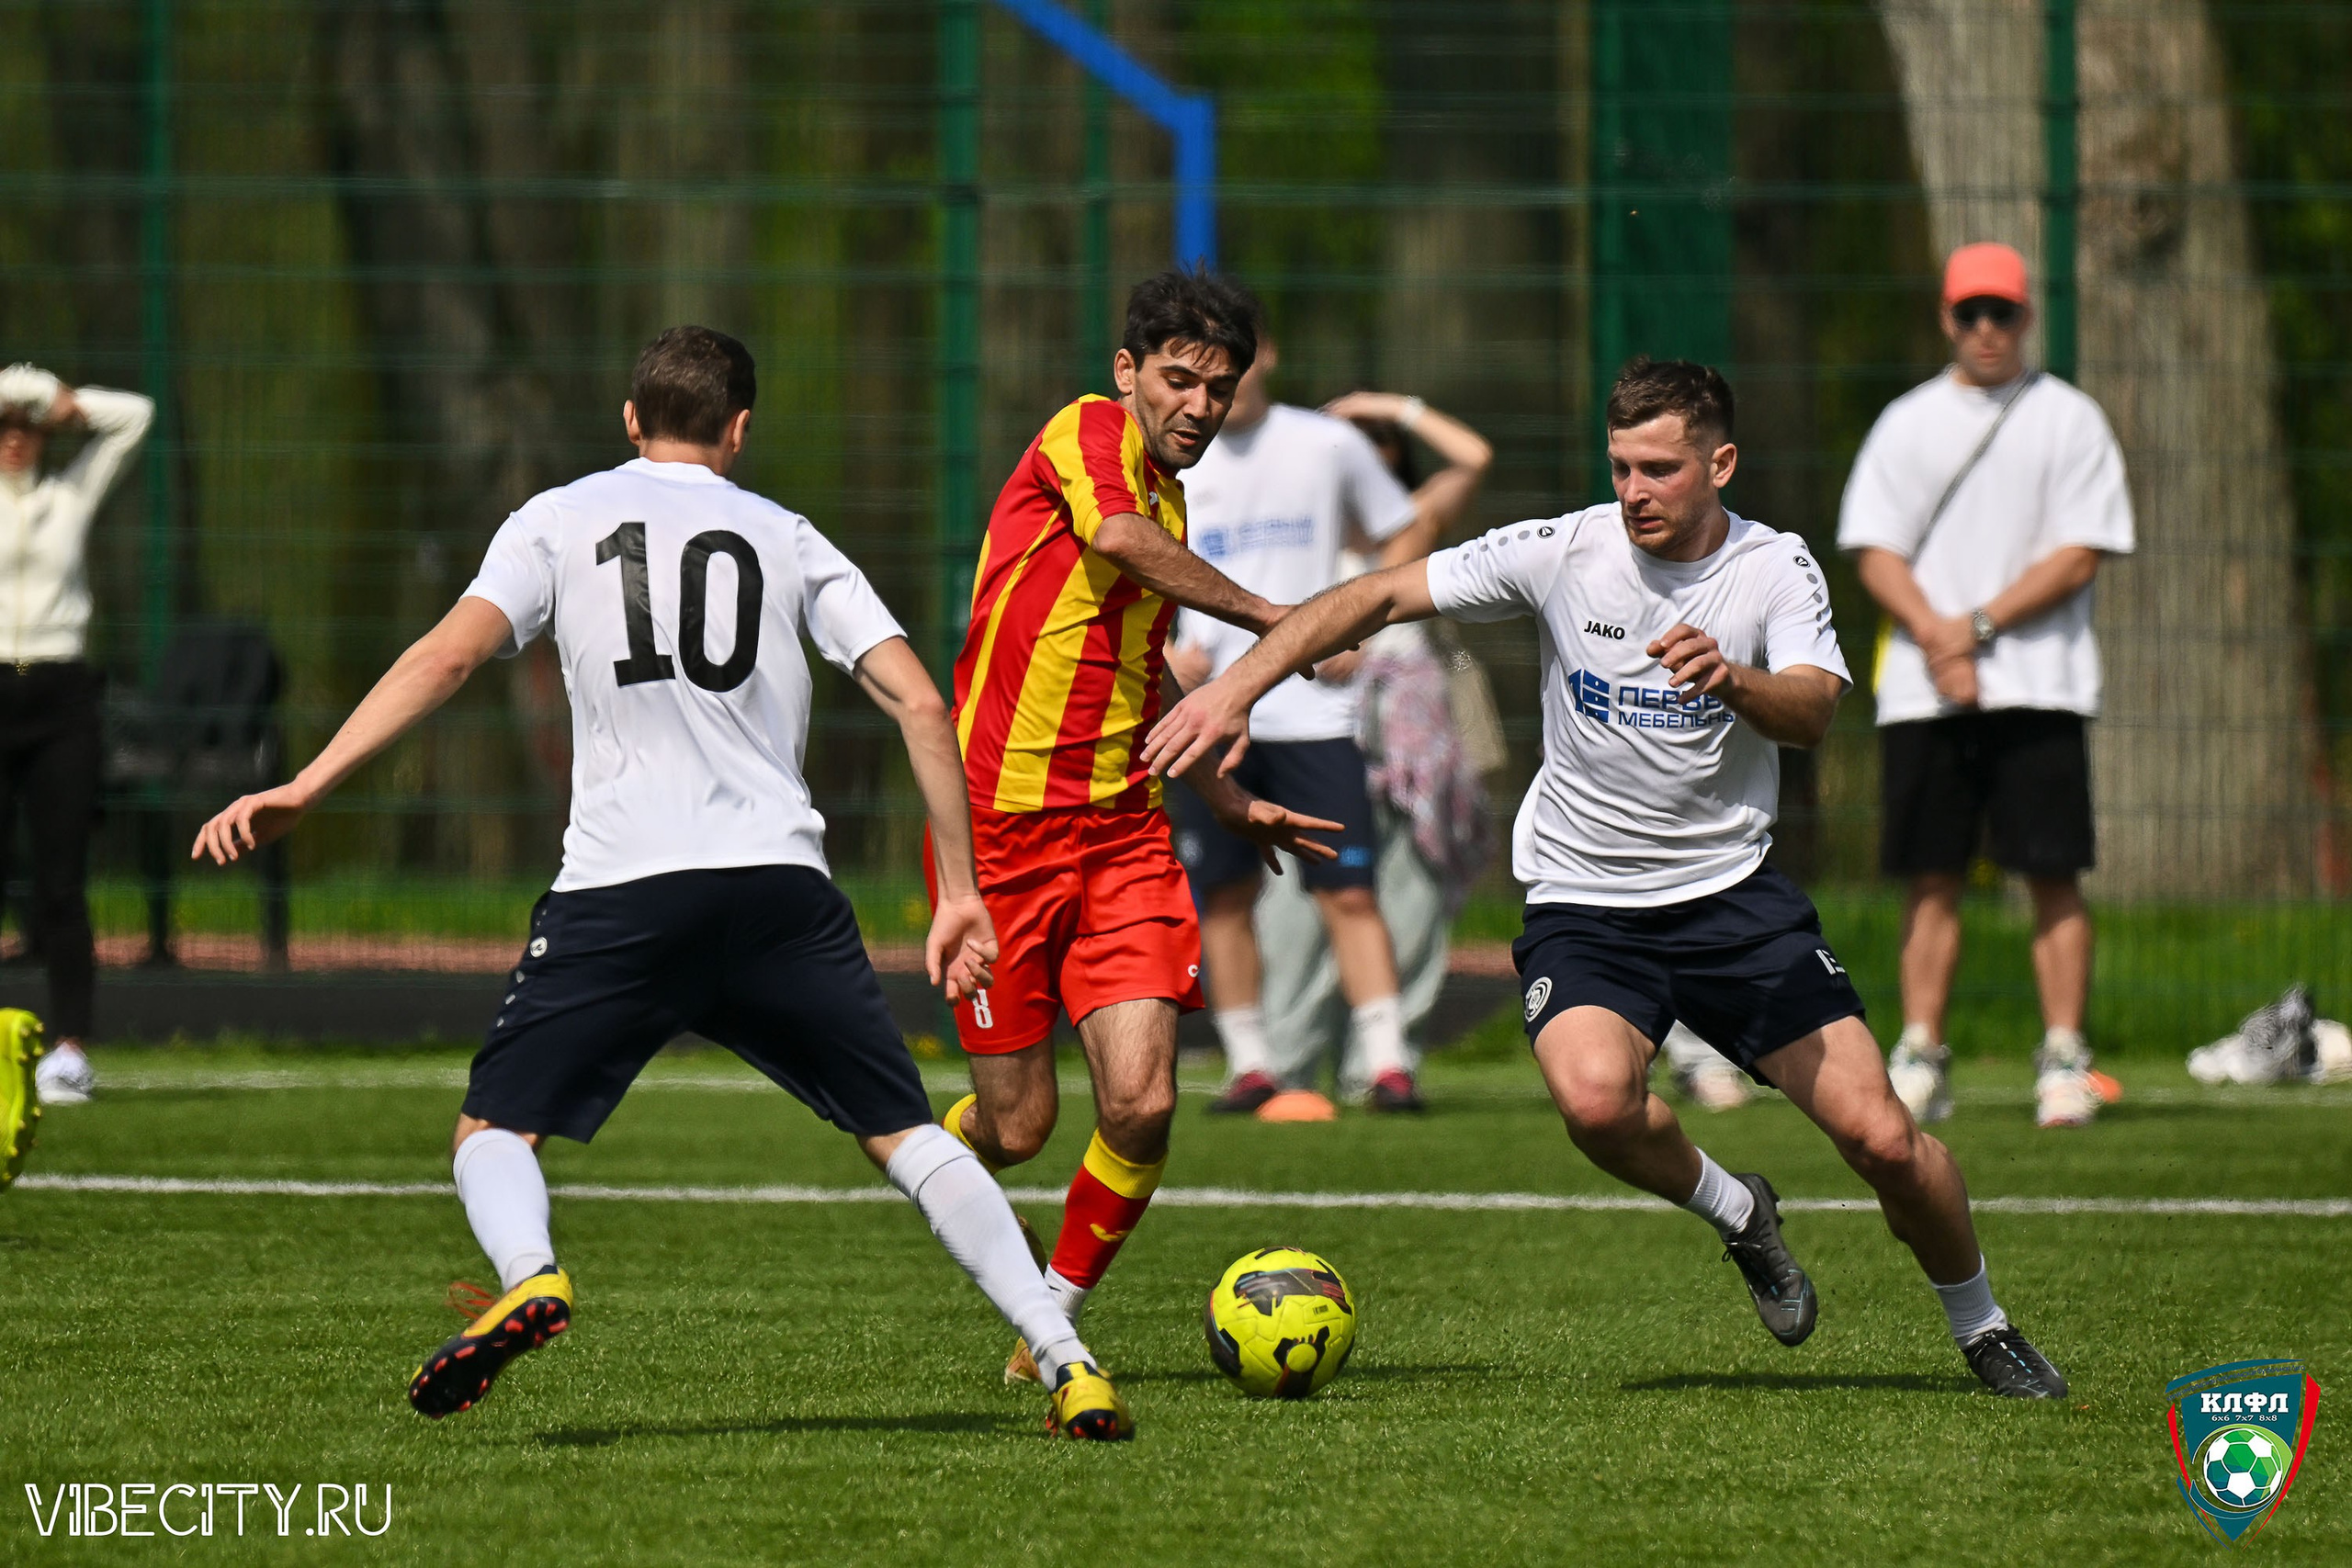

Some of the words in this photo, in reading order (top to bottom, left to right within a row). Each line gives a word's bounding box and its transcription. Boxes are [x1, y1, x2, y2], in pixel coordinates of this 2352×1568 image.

[595, 521, 763, 693] 10
[1584, 620, 1625, 640] JAKO
[972, 988, 993, 1029] 8
